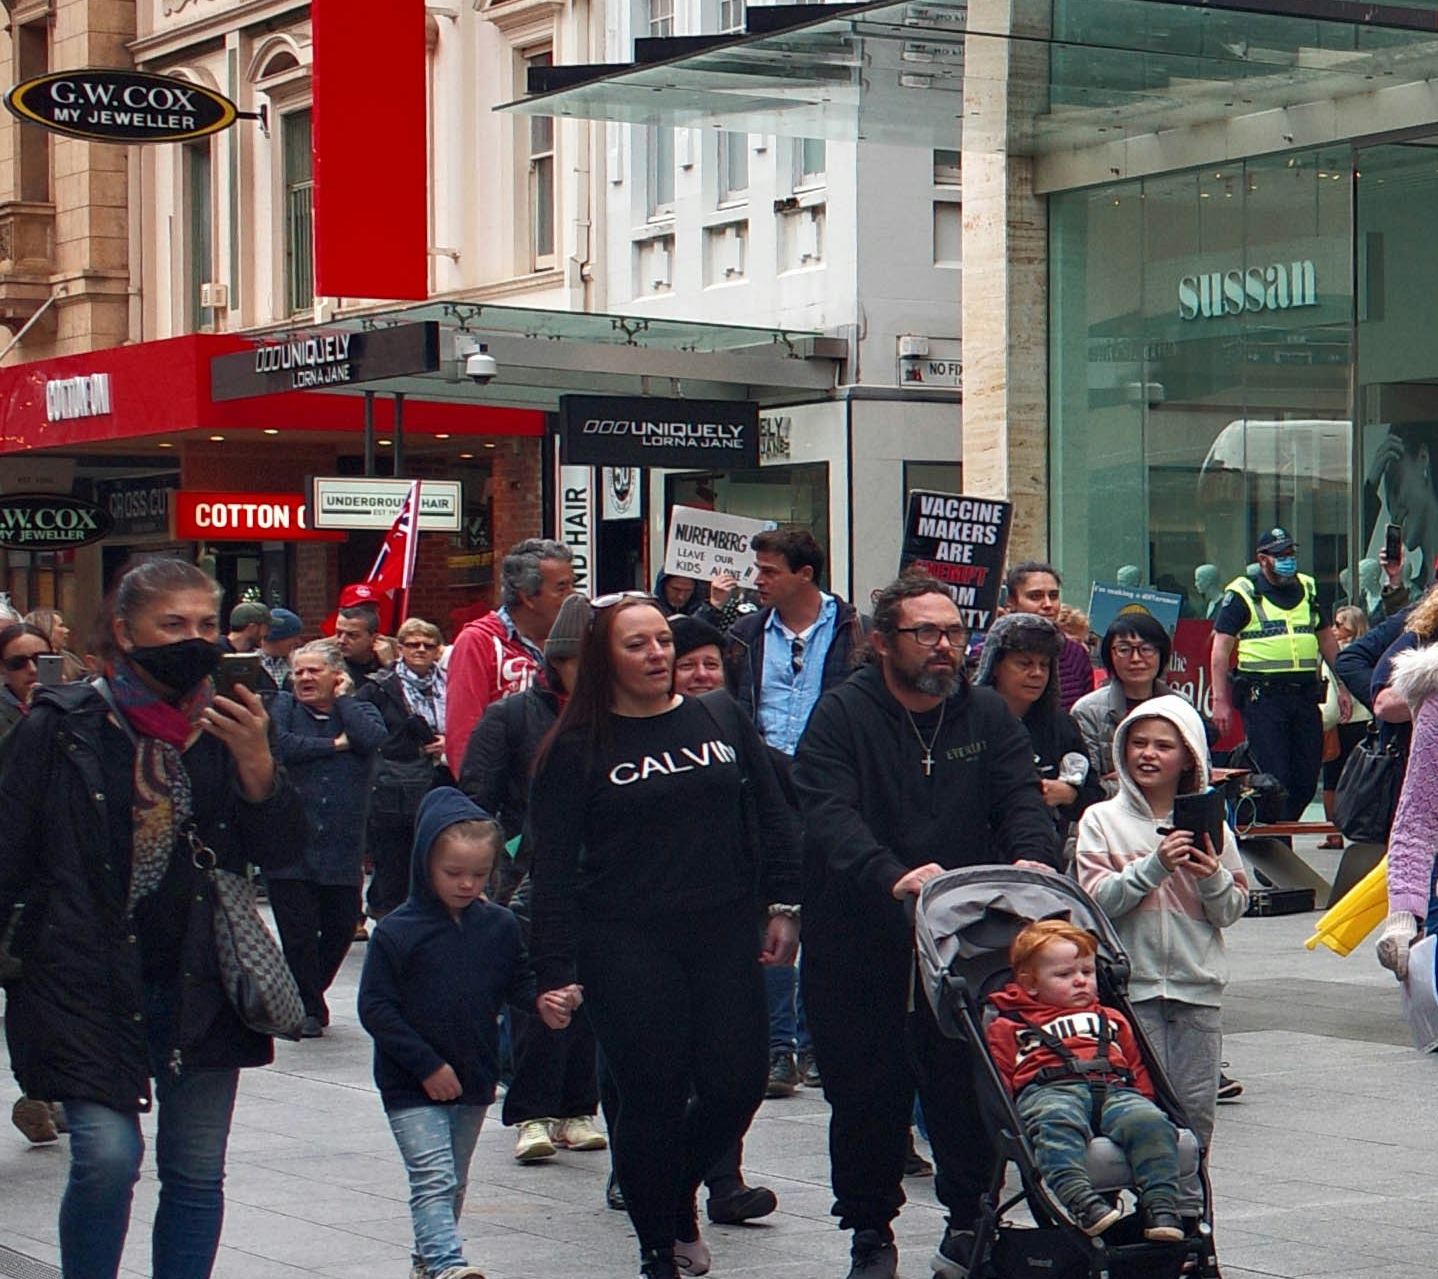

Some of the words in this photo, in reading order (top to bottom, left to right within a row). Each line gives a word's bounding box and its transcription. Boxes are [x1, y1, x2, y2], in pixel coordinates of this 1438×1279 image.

[53, 107, 81, 122] MY
[88, 110, 196, 130] JEWELLER
[1178, 258, 1318, 324] sussan
[280, 332, 351, 370] UNIQUELY
[929, 362, 946, 375] NO
[631, 421, 745, 438] UNIQUELY
[148, 487, 170, 516] CU
[326, 495, 408, 508] UNDERGROU
[421, 498, 451, 510] HAIR
[920, 495, 1003, 525] VACCINE
[35, 507, 98, 530] COX
[195, 503, 290, 529] COTTON
[565, 487, 588, 548] HAIR
[19, 528, 85, 543] JEWELLER
[675, 522, 748, 554] NUREMBERG
[918, 517, 998, 546] MAKERS
[677, 547, 705, 562] LEAVE
[714, 554, 734, 565] OUR
[935, 542, 974, 564] ARE
[675, 560, 701, 574] KIDS
[609, 739, 738, 786] CALVIN
